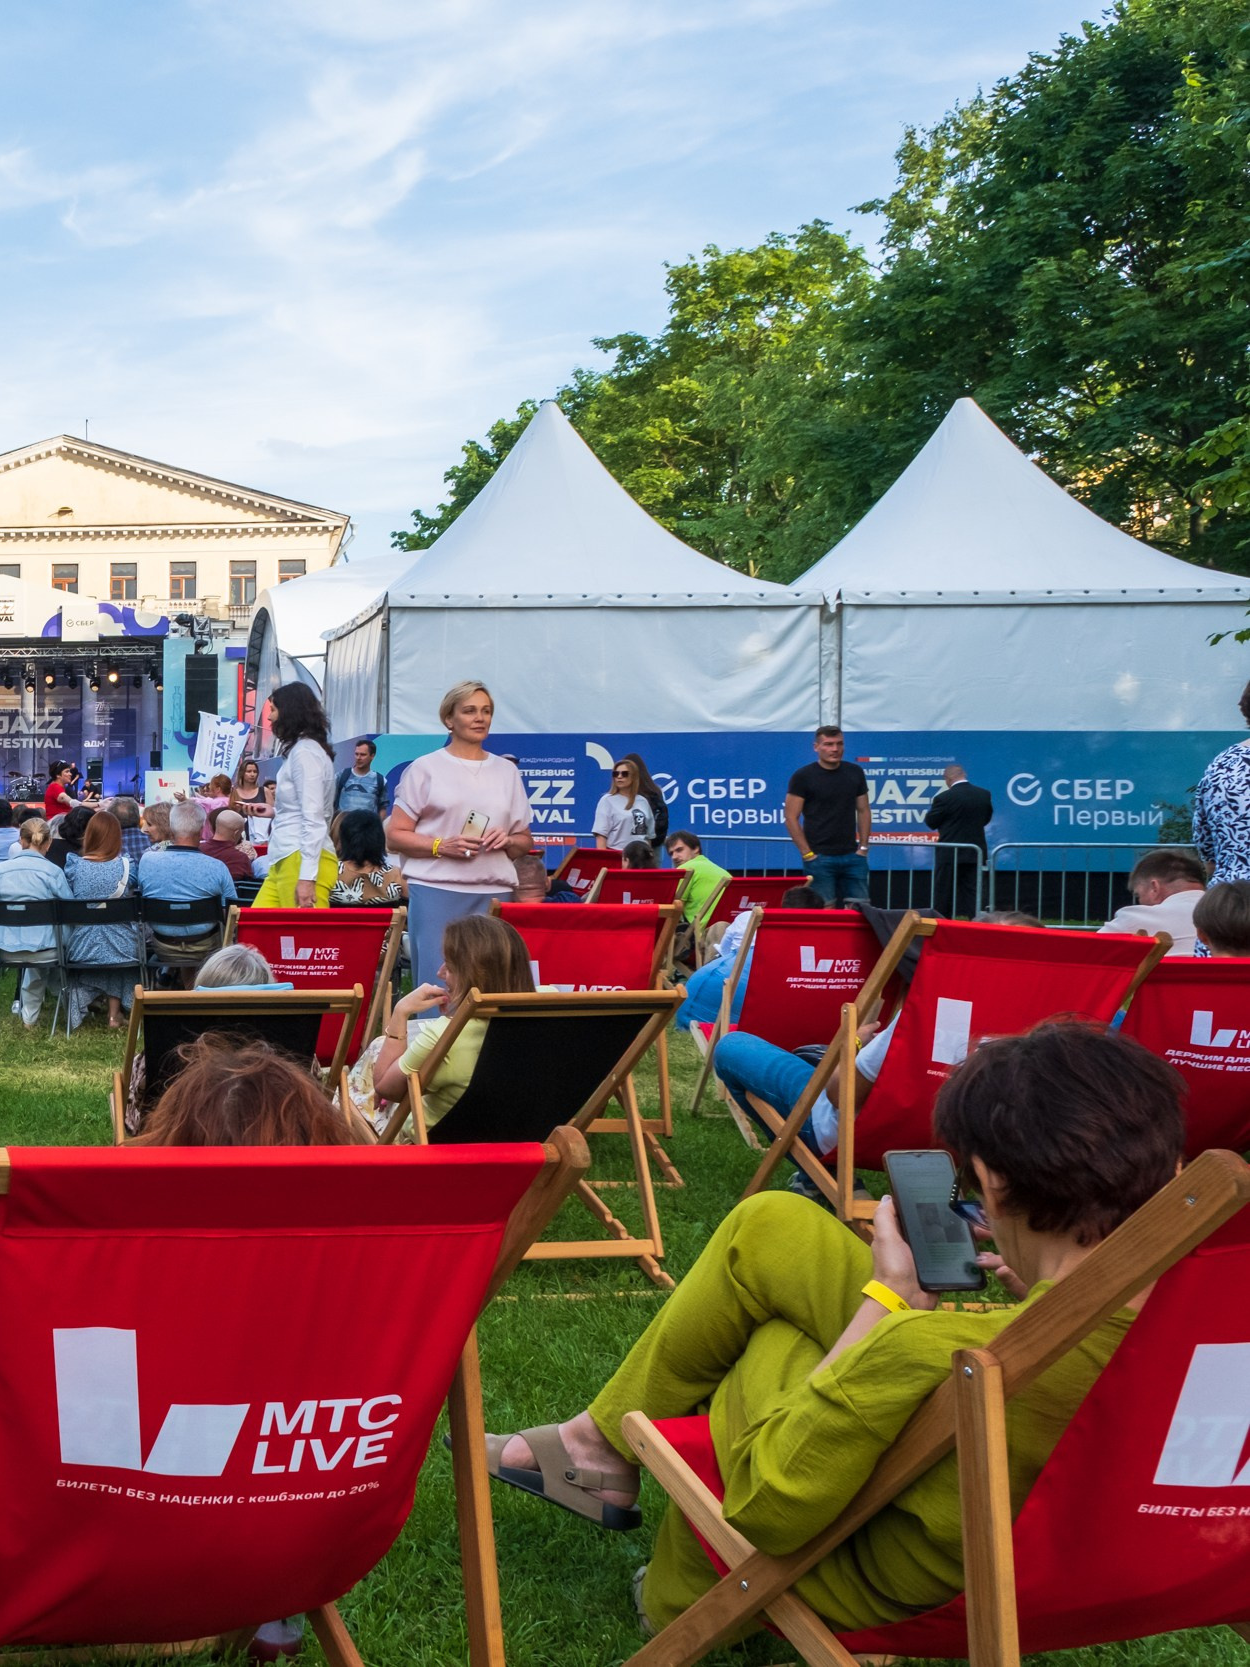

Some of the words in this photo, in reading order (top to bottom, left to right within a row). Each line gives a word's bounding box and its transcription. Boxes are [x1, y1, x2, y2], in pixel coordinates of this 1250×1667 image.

[528, 780, 575, 804] ZZ
[687, 778, 767, 799] СБЕР
[1051, 779, 1134, 800] СБЕР
[871, 809, 928, 823] ESTIV
[1054, 804, 1163, 830] Первый
[1165, 1049, 1224, 1062] ДЕРЖИМ
[1169, 1058, 1224, 1070] ЛУЧШИЕ
[260, 1394, 402, 1436] МТС
[251, 1431, 393, 1475] LIVE
[56, 1479, 122, 1494] БИЛЕТЫ
[126, 1488, 156, 1501] БЕЗ
[159, 1494, 233, 1506] НАЦЕНКИ
[249, 1490, 324, 1503] кешбэком
[326, 1490, 346, 1500] до
[348, 1480, 380, 1494] 20%
[1137, 1504, 1205, 1517] БИЛЕТЫ
[1207, 1507, 1235, 1517] БЕЗ
